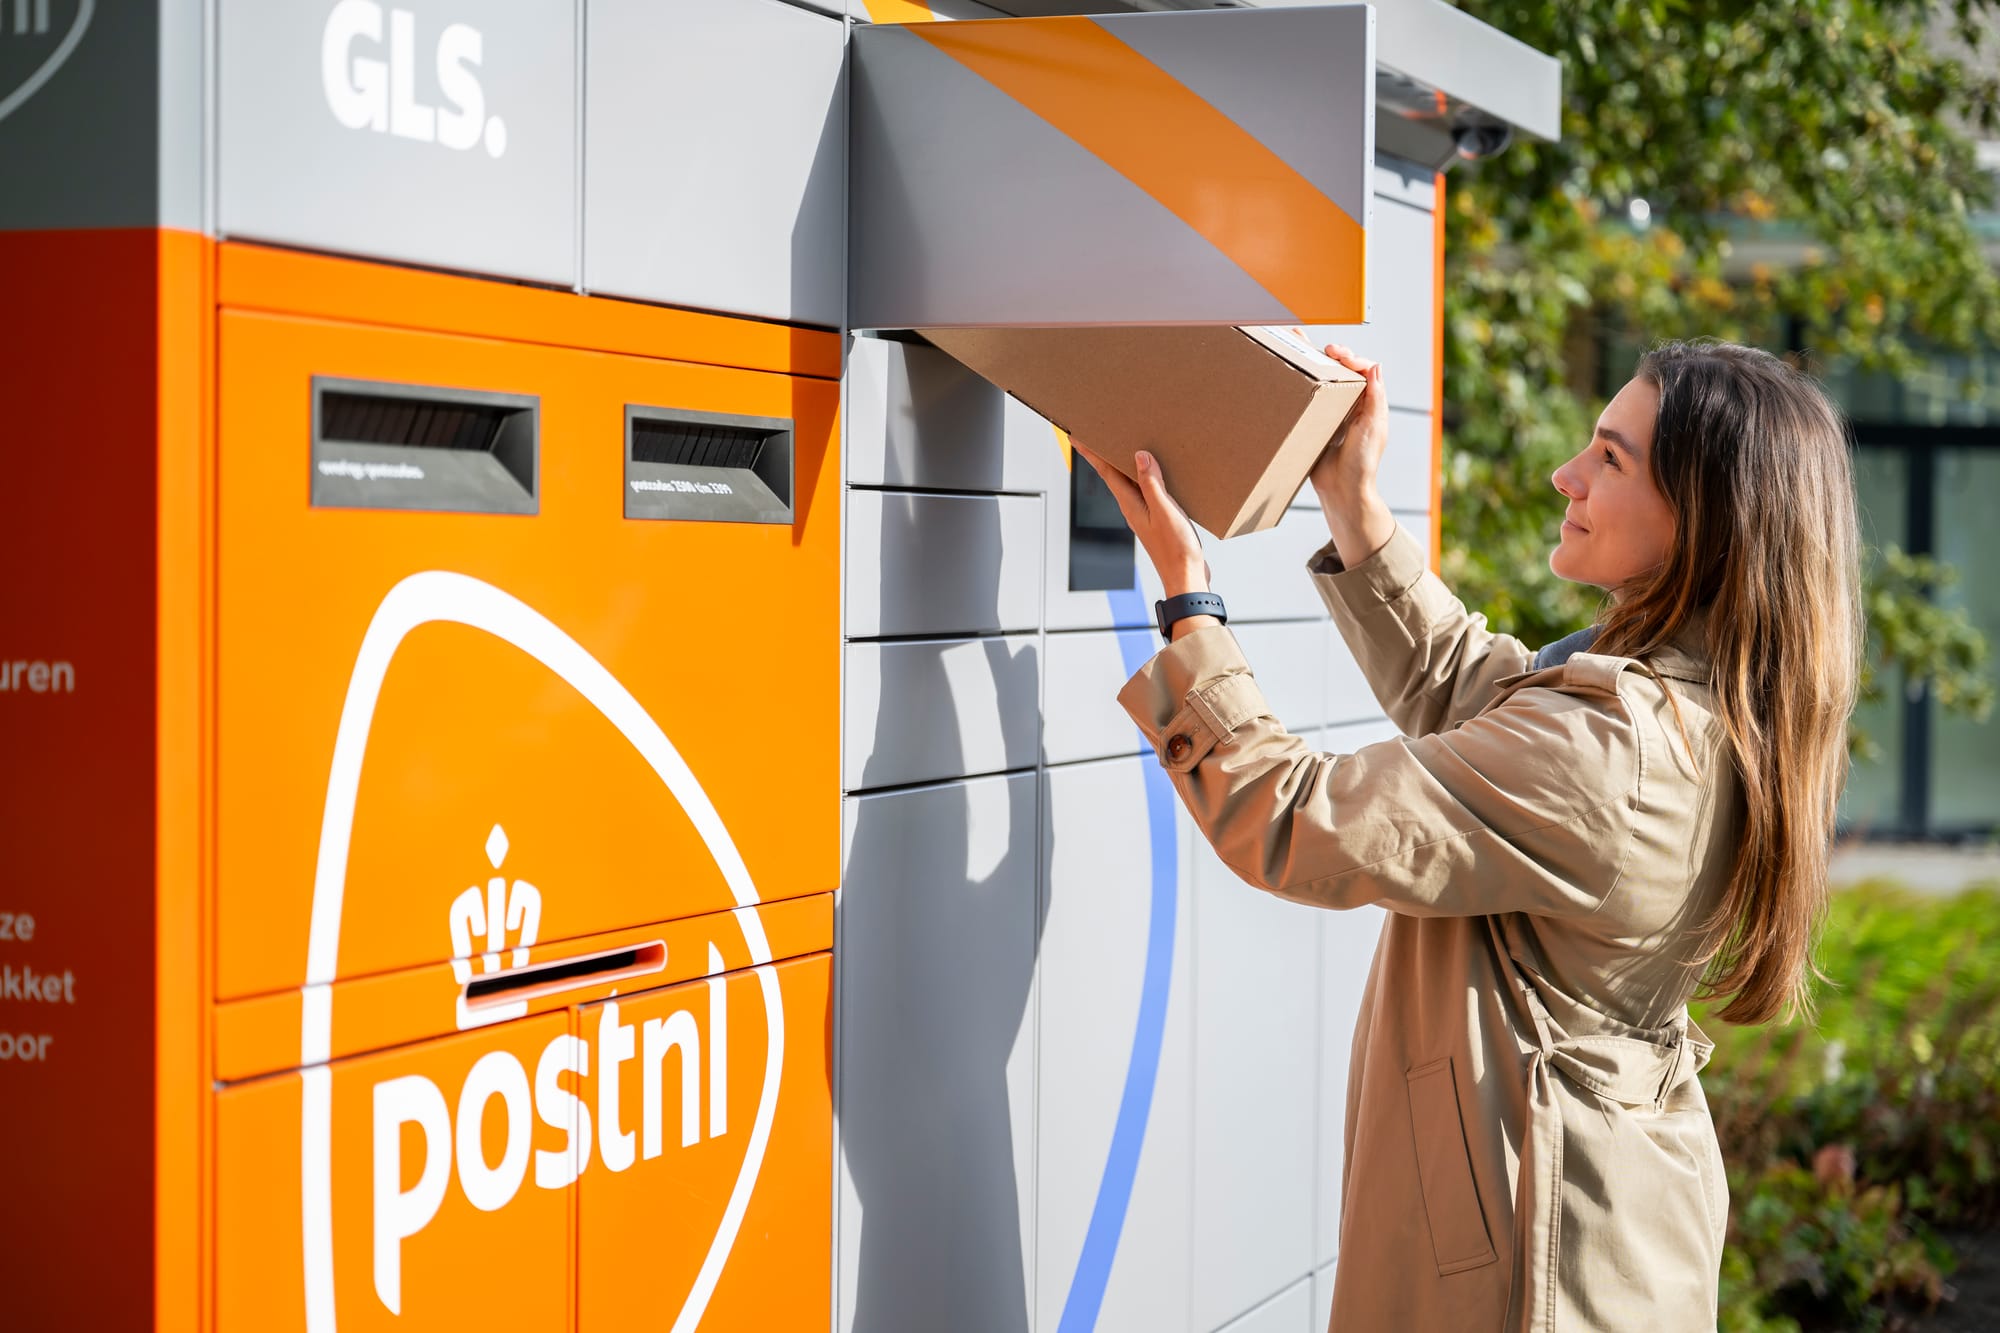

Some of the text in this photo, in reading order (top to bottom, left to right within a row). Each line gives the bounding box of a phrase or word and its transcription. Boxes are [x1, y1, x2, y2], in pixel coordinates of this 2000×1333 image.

[322, 0, 507, 158] GLS.
[0, 964, 76, 1003] kket
[373, 940, 727, 1316] postnl
